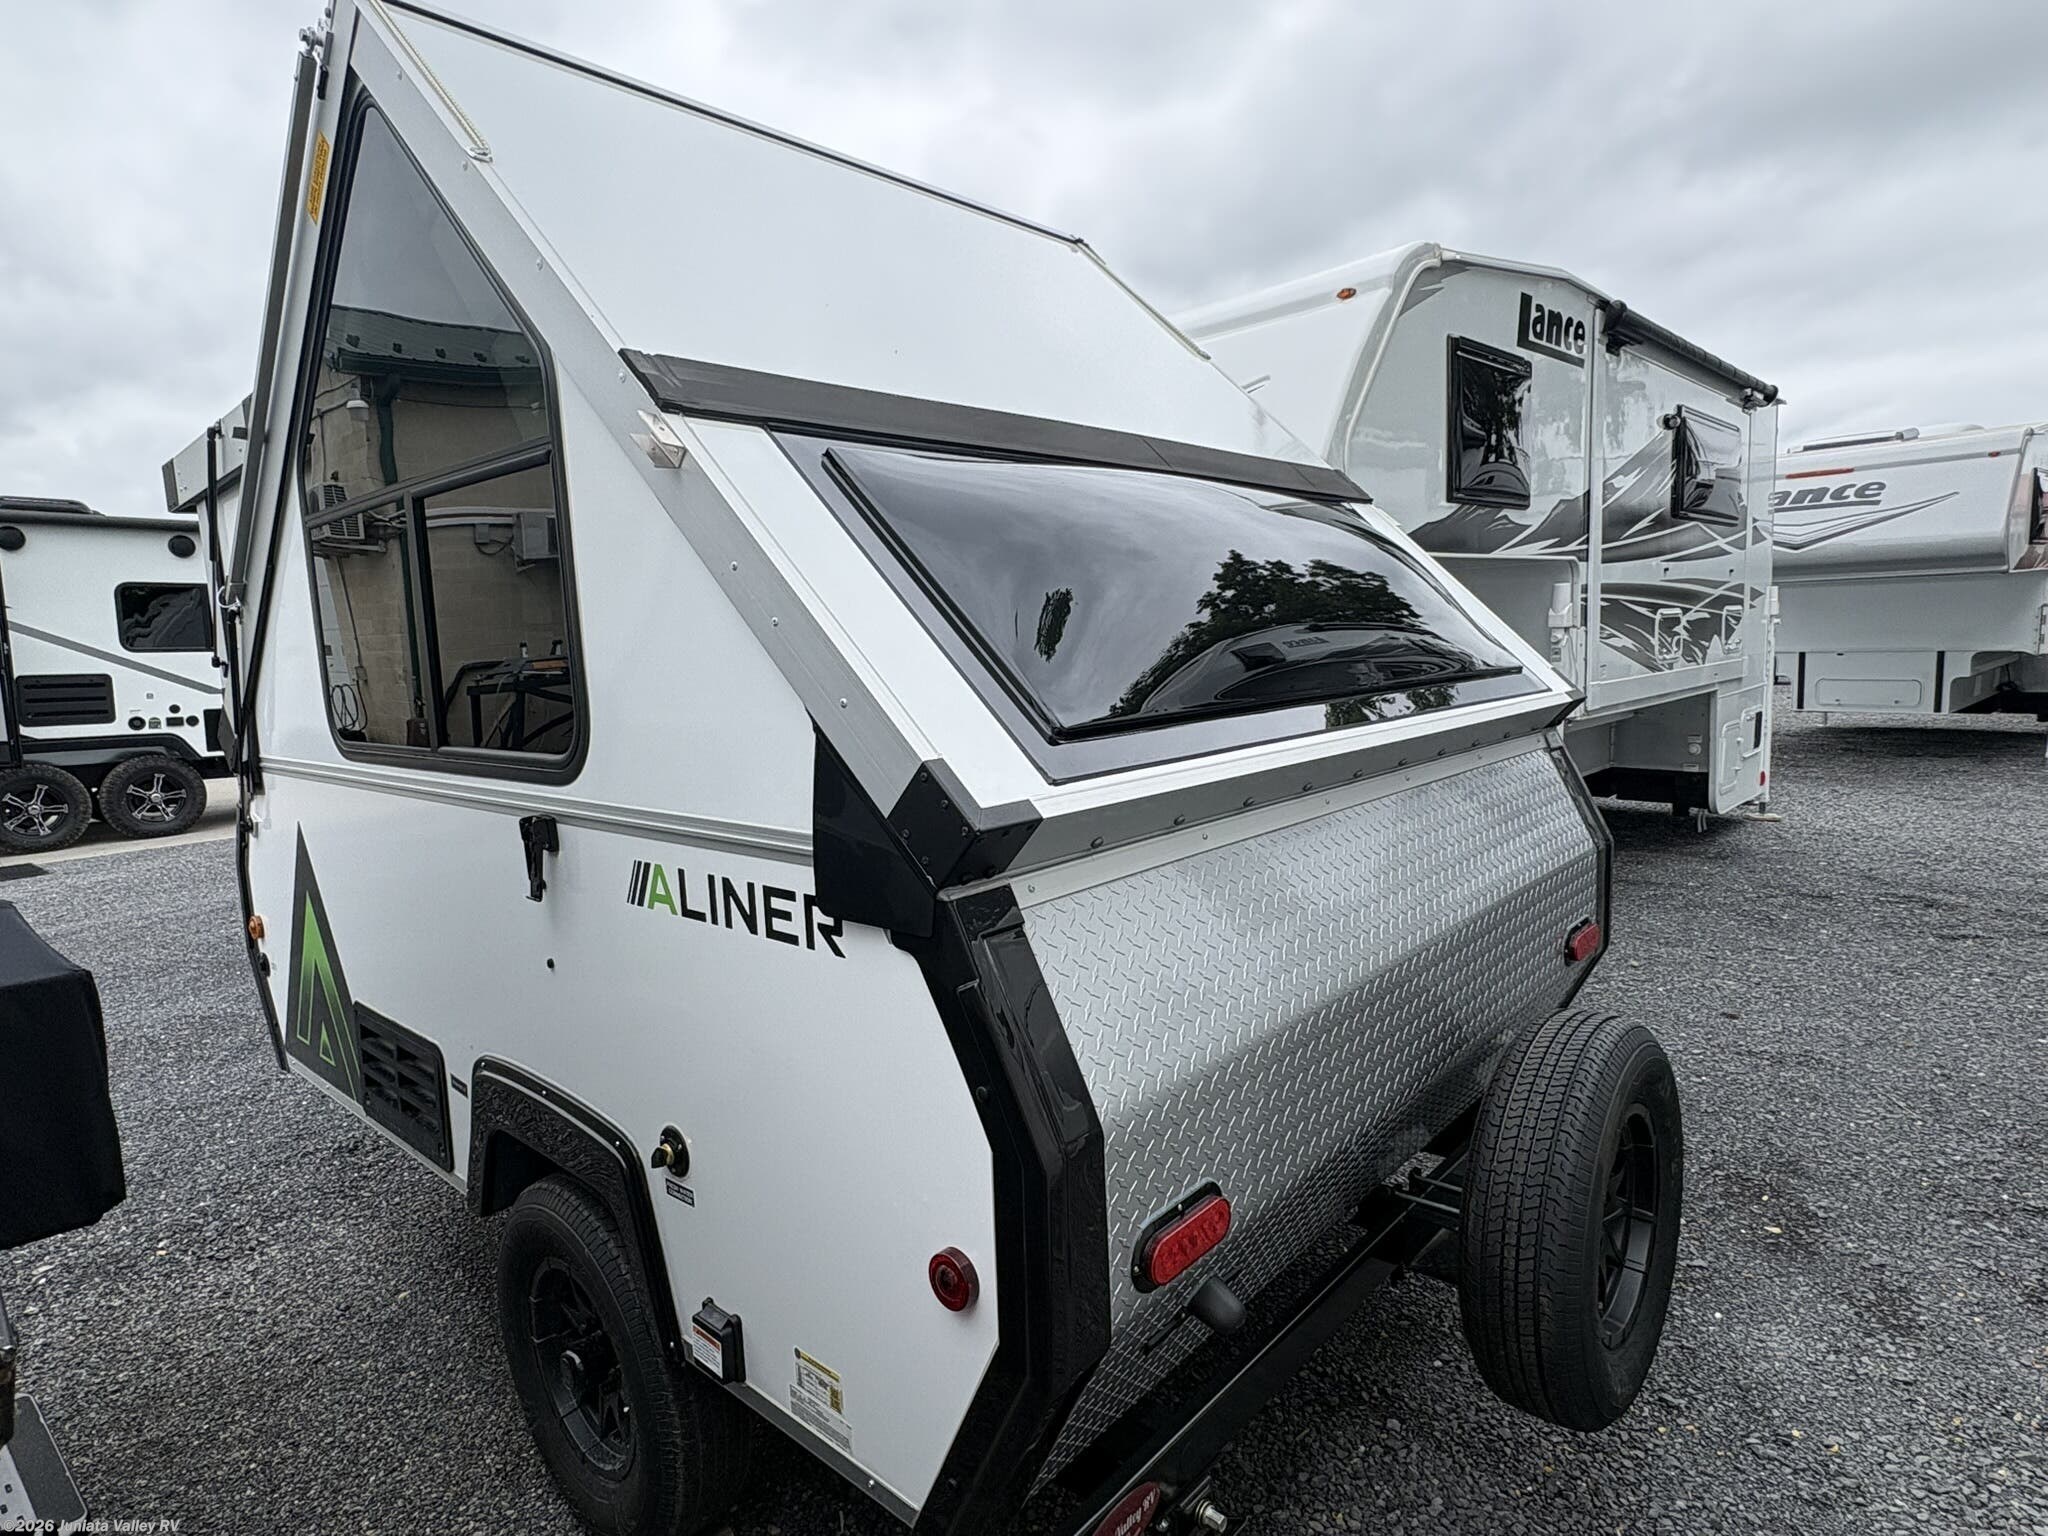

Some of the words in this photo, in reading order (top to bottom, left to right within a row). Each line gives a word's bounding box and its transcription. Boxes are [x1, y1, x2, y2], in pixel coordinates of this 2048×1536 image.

[1517, 292, 1585, 368] Lance
[1768, 481, 1887, 513] ance
[646, 861, 847, 959] ALINER
